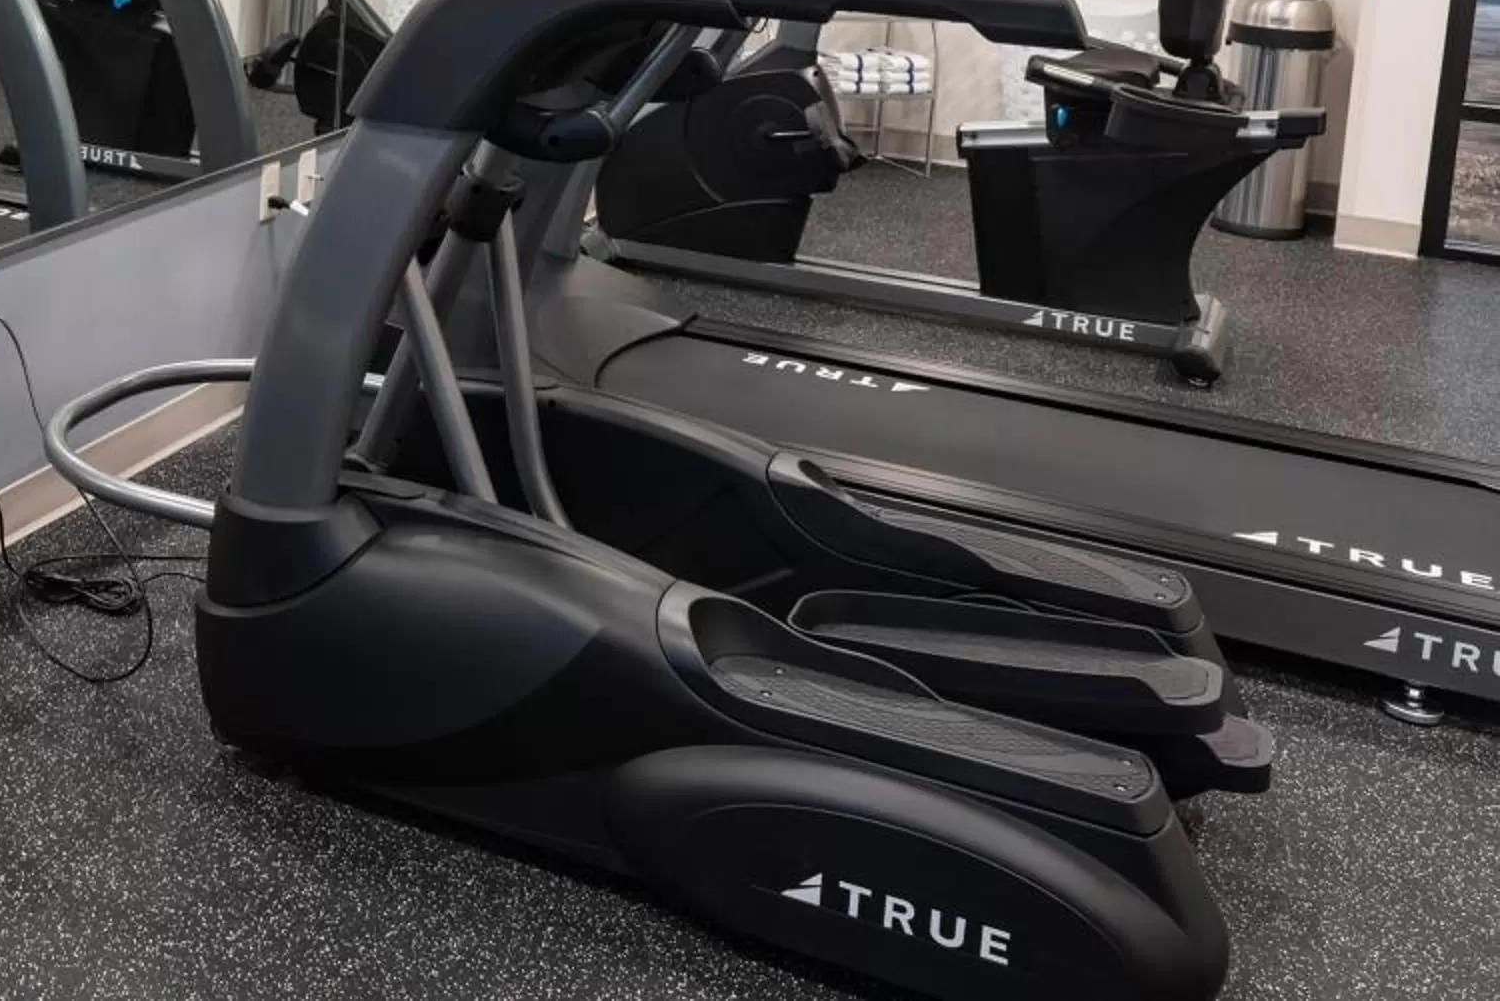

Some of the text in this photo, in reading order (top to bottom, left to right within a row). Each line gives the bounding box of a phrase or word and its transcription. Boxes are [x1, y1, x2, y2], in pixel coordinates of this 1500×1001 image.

[1051, 312, 1135, 341] TRUE
[742, 353, 879, 388] TRUE
[1297, 536, 1495, 590] TRUE
[1414, 632, 1500, 678] TR
[838, 880, 1011, 966] TRUE
